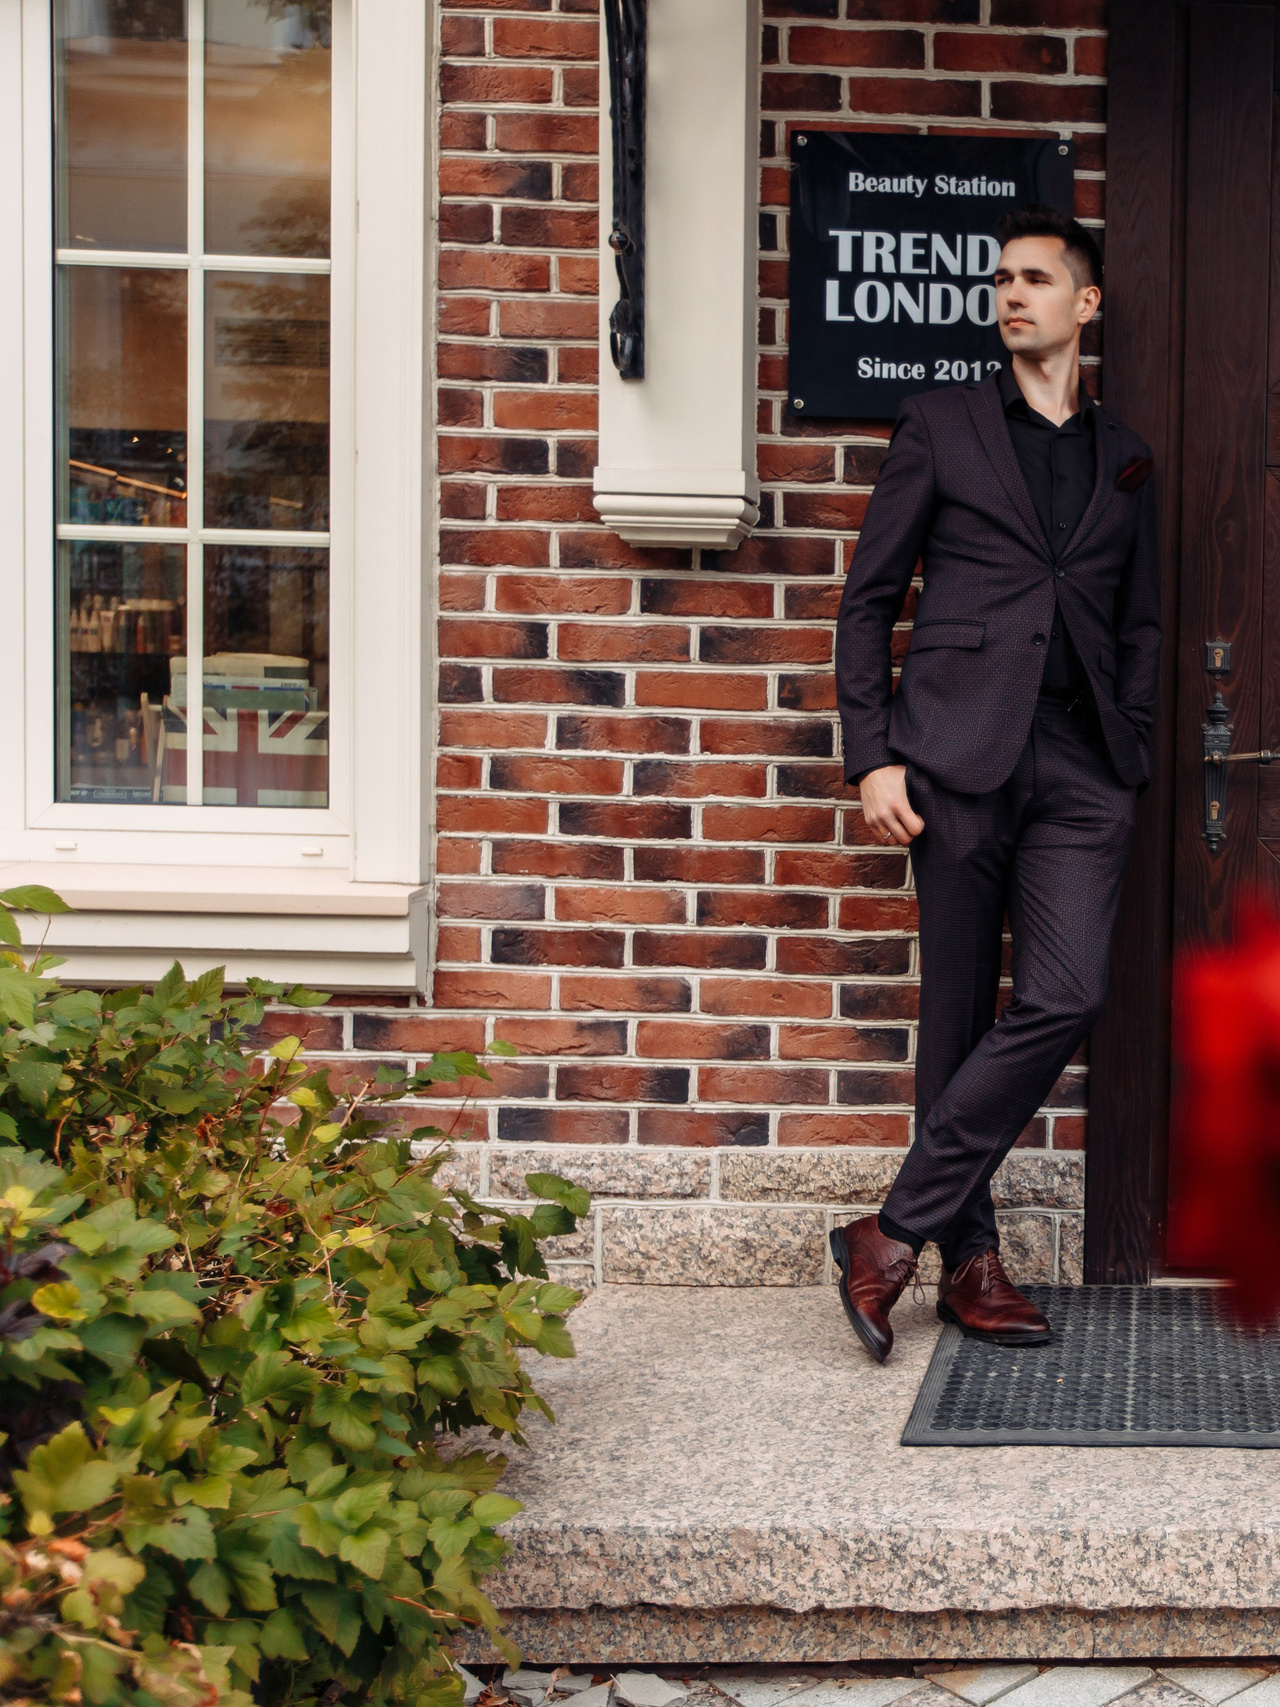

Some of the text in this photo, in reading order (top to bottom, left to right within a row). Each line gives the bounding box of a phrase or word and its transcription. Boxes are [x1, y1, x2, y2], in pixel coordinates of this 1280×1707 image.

[848, 172, 1015, 198] Beauty Station
[825, 279, 998, 327] LONDO
[857, 357, 925, 379] Since
